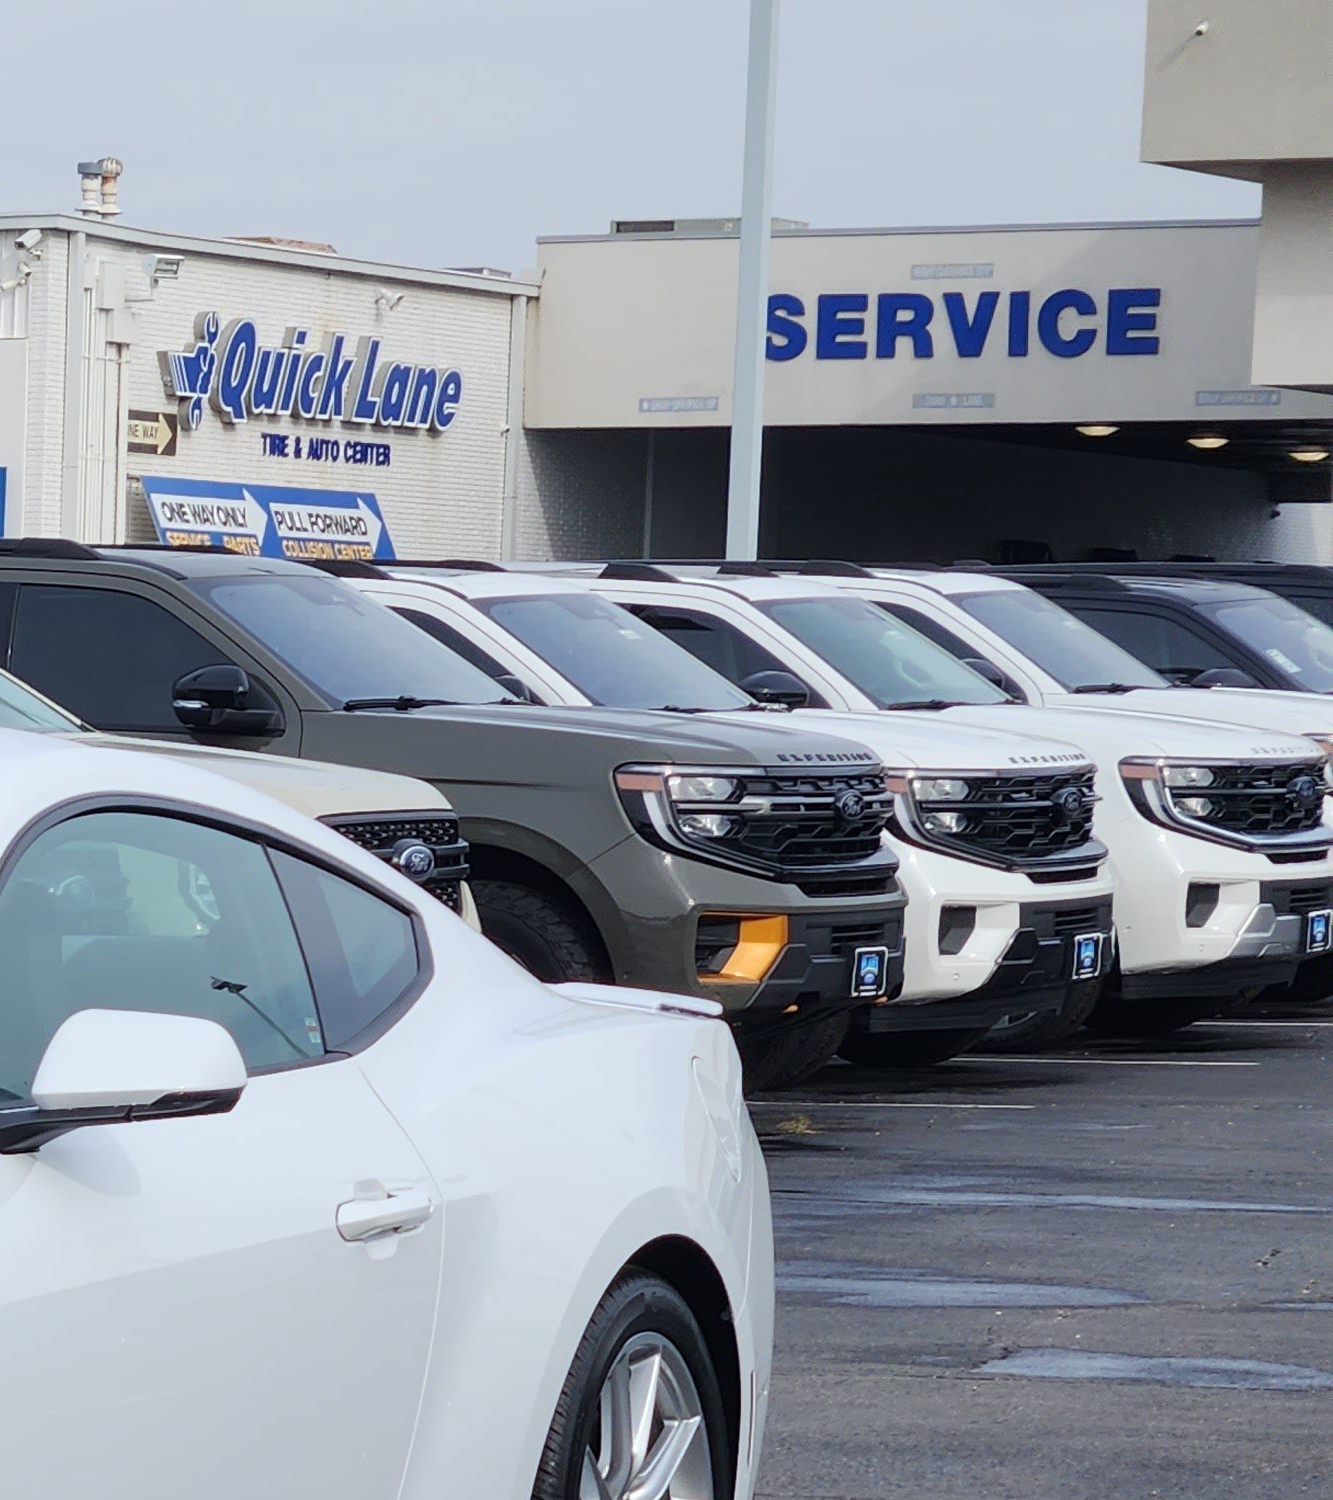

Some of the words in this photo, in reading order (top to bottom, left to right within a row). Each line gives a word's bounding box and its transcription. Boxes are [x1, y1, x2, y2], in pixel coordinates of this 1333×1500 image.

[765, 286, 1161, 362] SERVICE
[216, 317, 356, 425] Quick
[351, 336, 464, 434] Lane
[127, 424, 140, 439] NE
[142, 425, 159, 440] WAY
[261, 432, 289, 457] TIRE
[294, 436, 302, 459] &
[307, 438, 339, 463] AUTO
[344, 442, 391, 467] CENTER
[161, 501, 188, 524] ONE
[188, 504, 215, 526] WAY
[216, 504, 247, 528] ONLY
[275, 509, 308, 532] PULL
[310, 511, 368, 537] FORWARD
[223, 535, 261, 556] PARTS
[282, 539, 333, 559] COLLISION
[334, 542, 374, 560] CENTER
